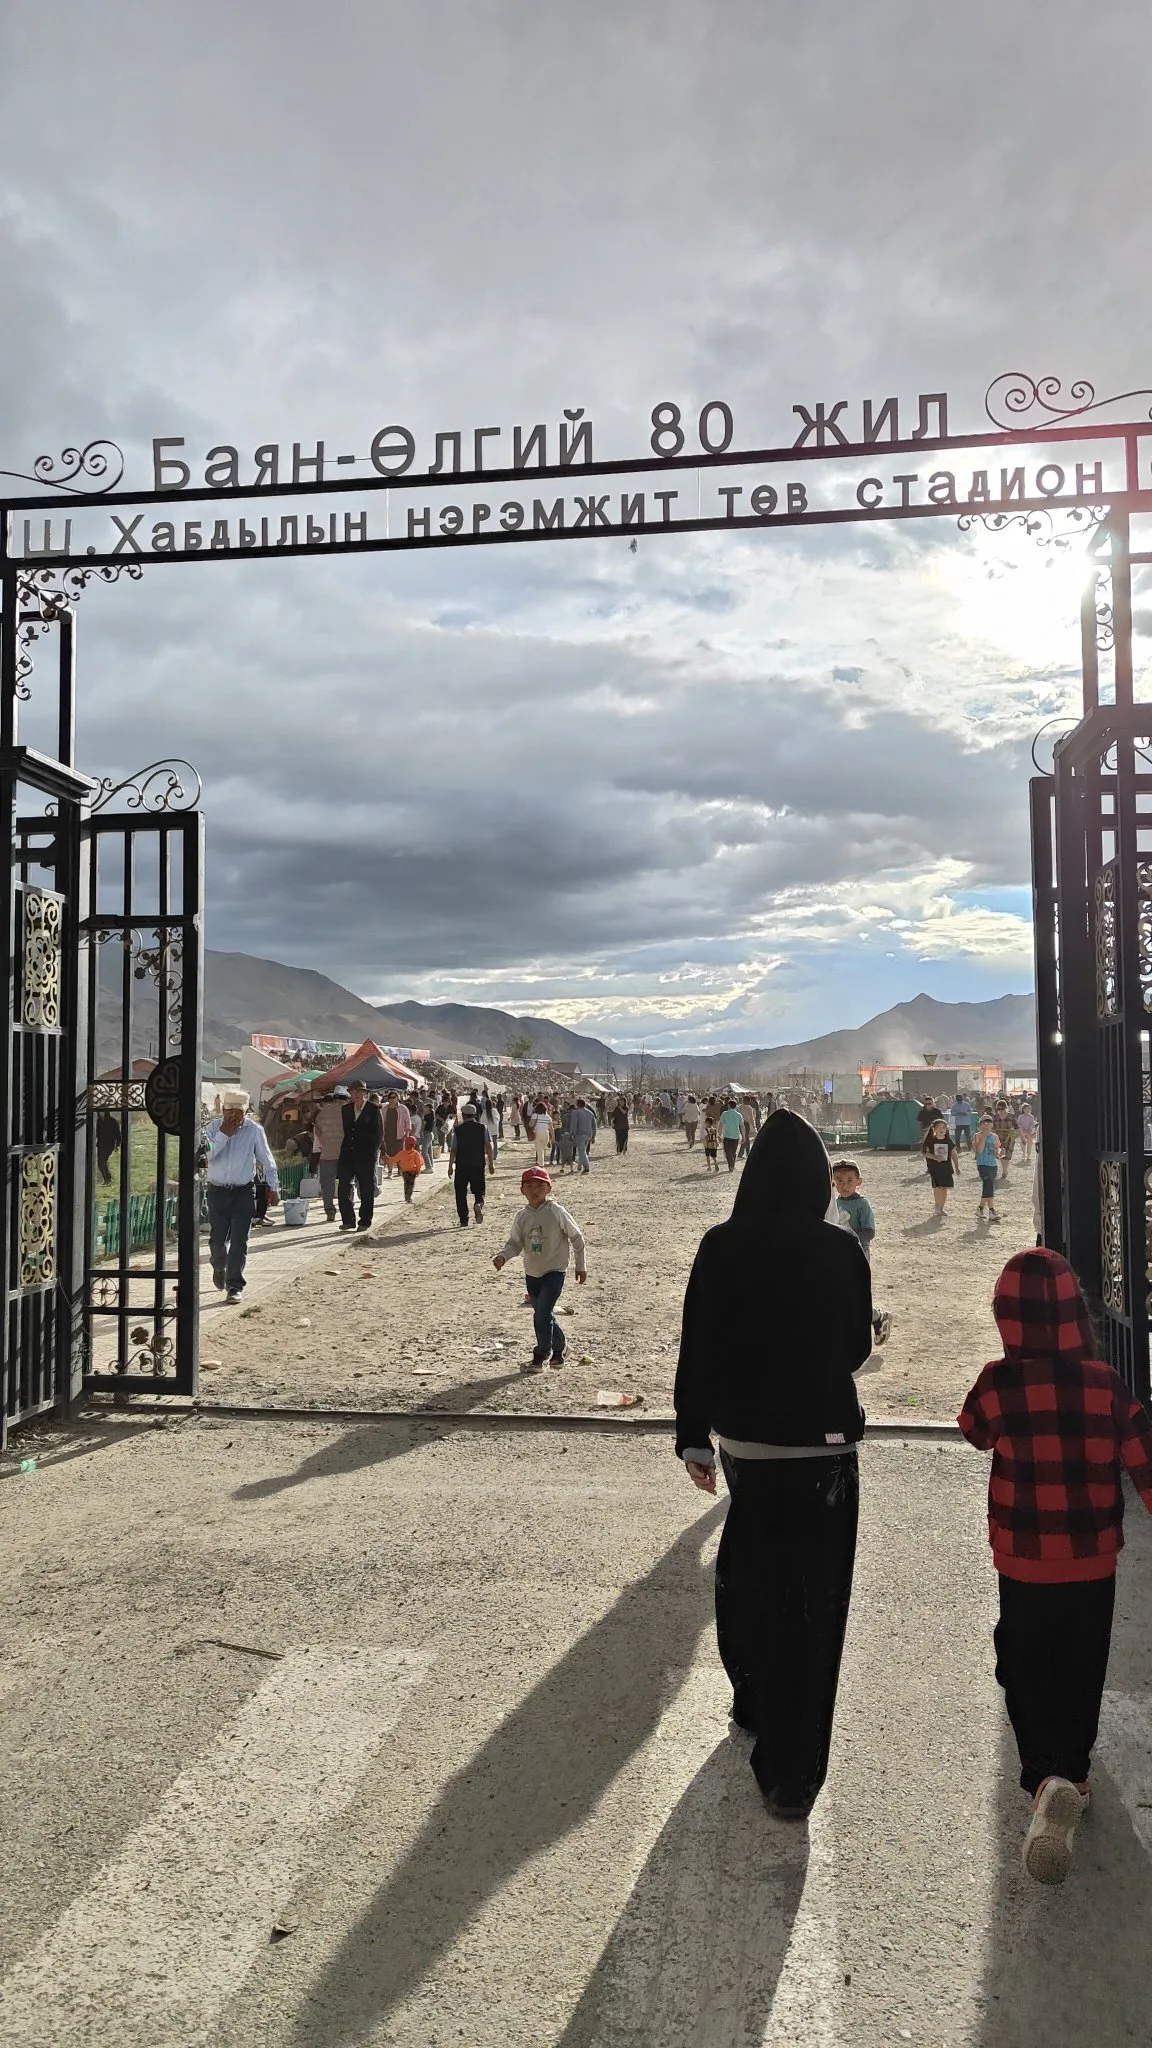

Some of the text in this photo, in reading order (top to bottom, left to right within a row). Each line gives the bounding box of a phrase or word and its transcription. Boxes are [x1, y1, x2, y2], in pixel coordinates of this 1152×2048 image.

[153, 408, 593, 492] Баян-Өлгий
[650, 401, 733, 457] 80
[407, 491, 678, 538] нэрэмжит
[718, 483, 808, 518] төв
[856, 462, 1102, 509] стадион
[825, 1433, 846, 1443] MARVEL
